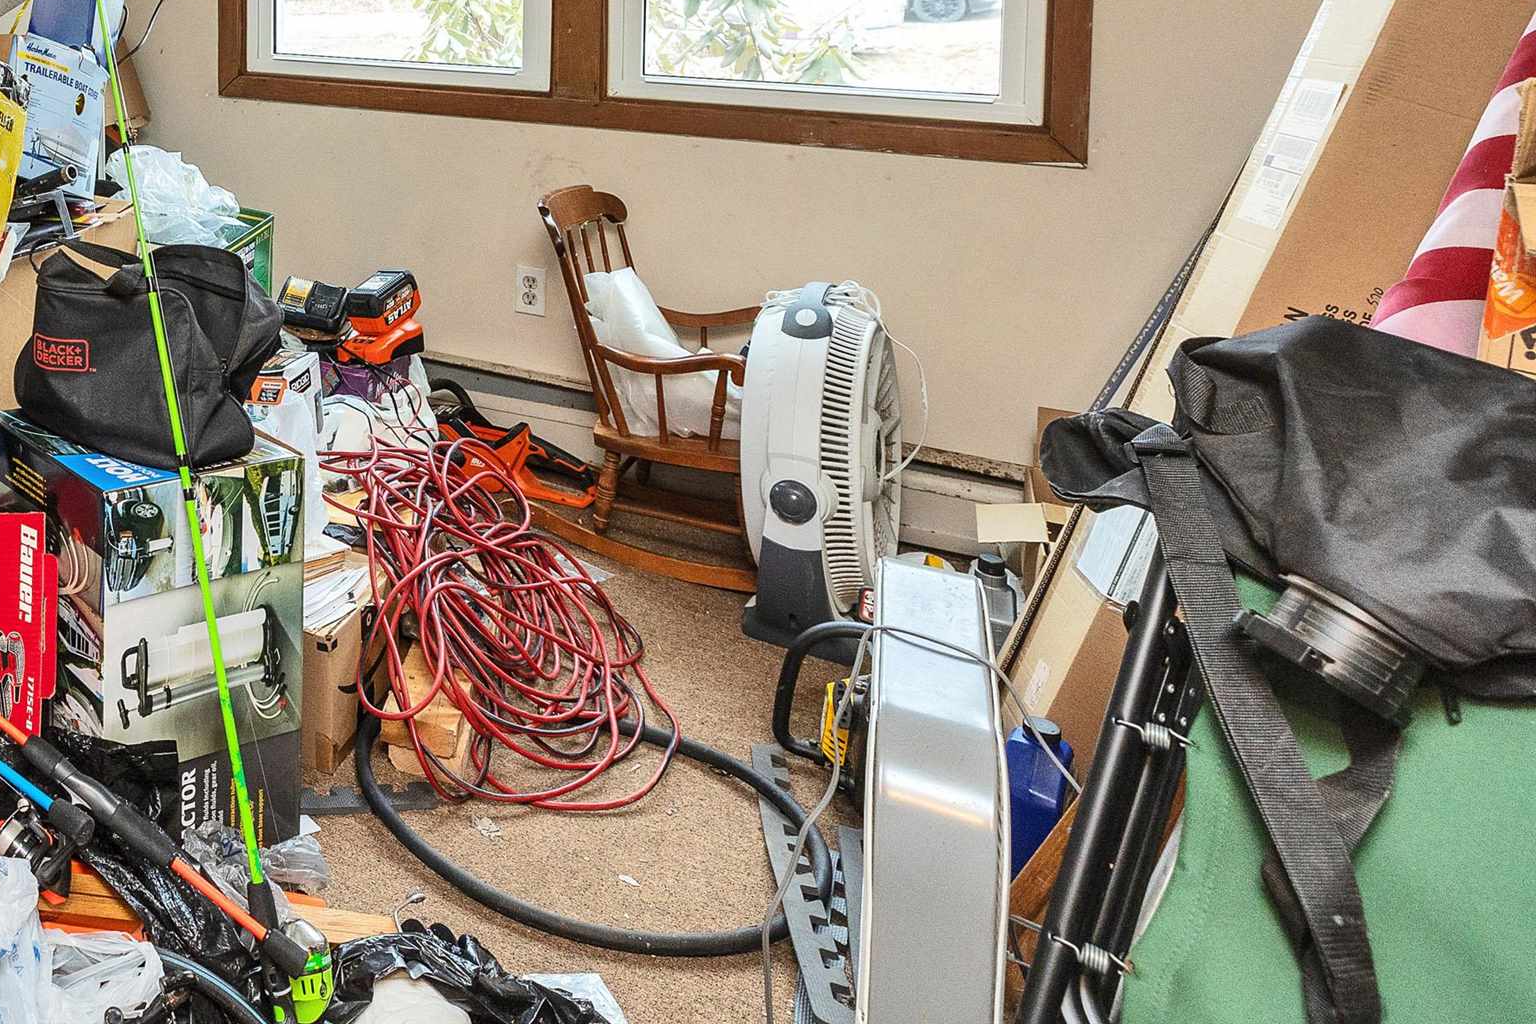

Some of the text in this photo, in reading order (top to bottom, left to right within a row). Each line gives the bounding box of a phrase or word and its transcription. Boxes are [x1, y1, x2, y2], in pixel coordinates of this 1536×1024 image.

[24, 62, 74, 88] TRAILERABLE
[74, 80, 88, 94] BOAT
[386, 299, 411, 324] ATLAS
[37, 339, 82, 355] BLACK+
[37, 350, 82, 366] DECKER
[1112, 304, 1164, 382] EXTENDABLE
[18, 524, 39, 624] Bauer
[202, 768, 210, 800] including
